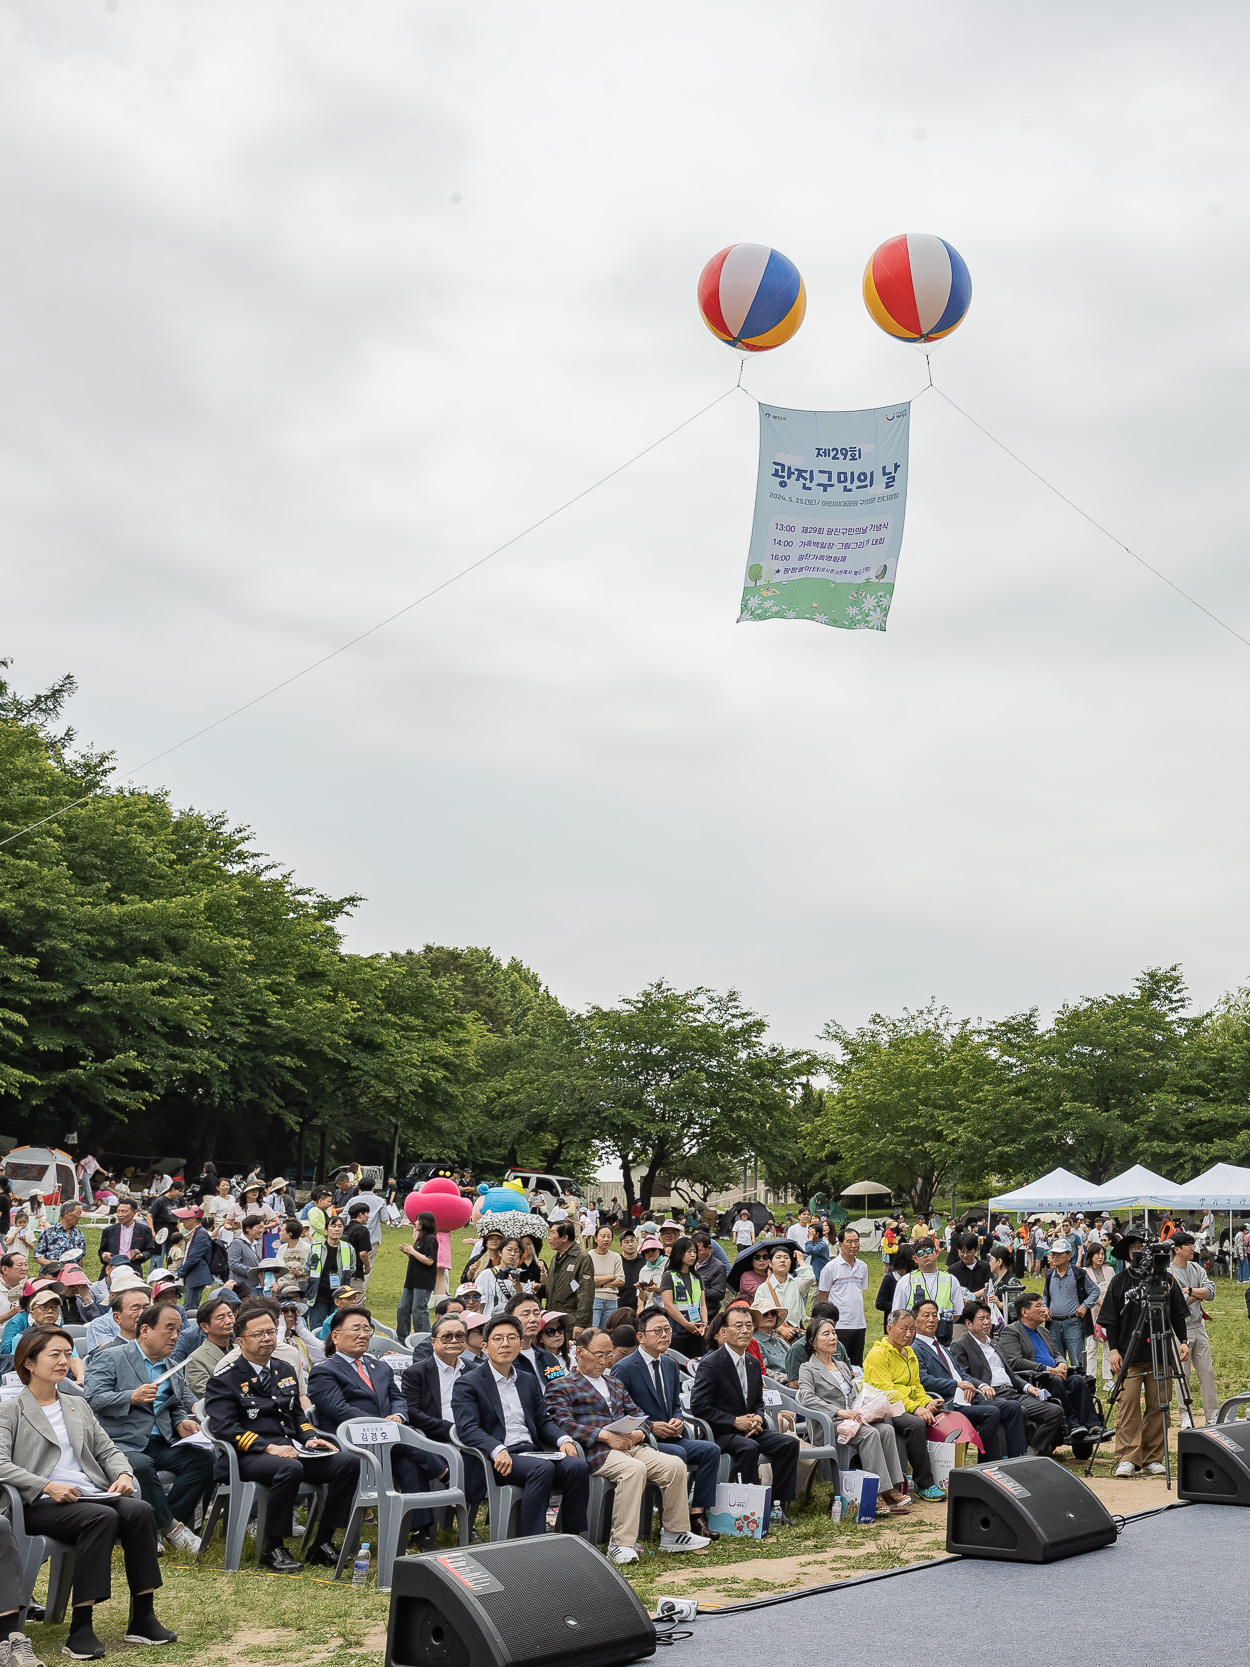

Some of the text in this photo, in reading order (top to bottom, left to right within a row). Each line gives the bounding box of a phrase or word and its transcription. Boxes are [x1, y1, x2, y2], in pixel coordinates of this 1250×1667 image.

[815, 446, 862, 461] 제29회
[771, 461, 900, 493] 광진구민의 날
[769, 492, 787, 502] 2024.
[774, 522, 796, 532] 13:00
[801, 526, 824, 535] 제29회
[772, 538, 794, 548] 14:00
[361, 1432, 388, 1441] 김경호
